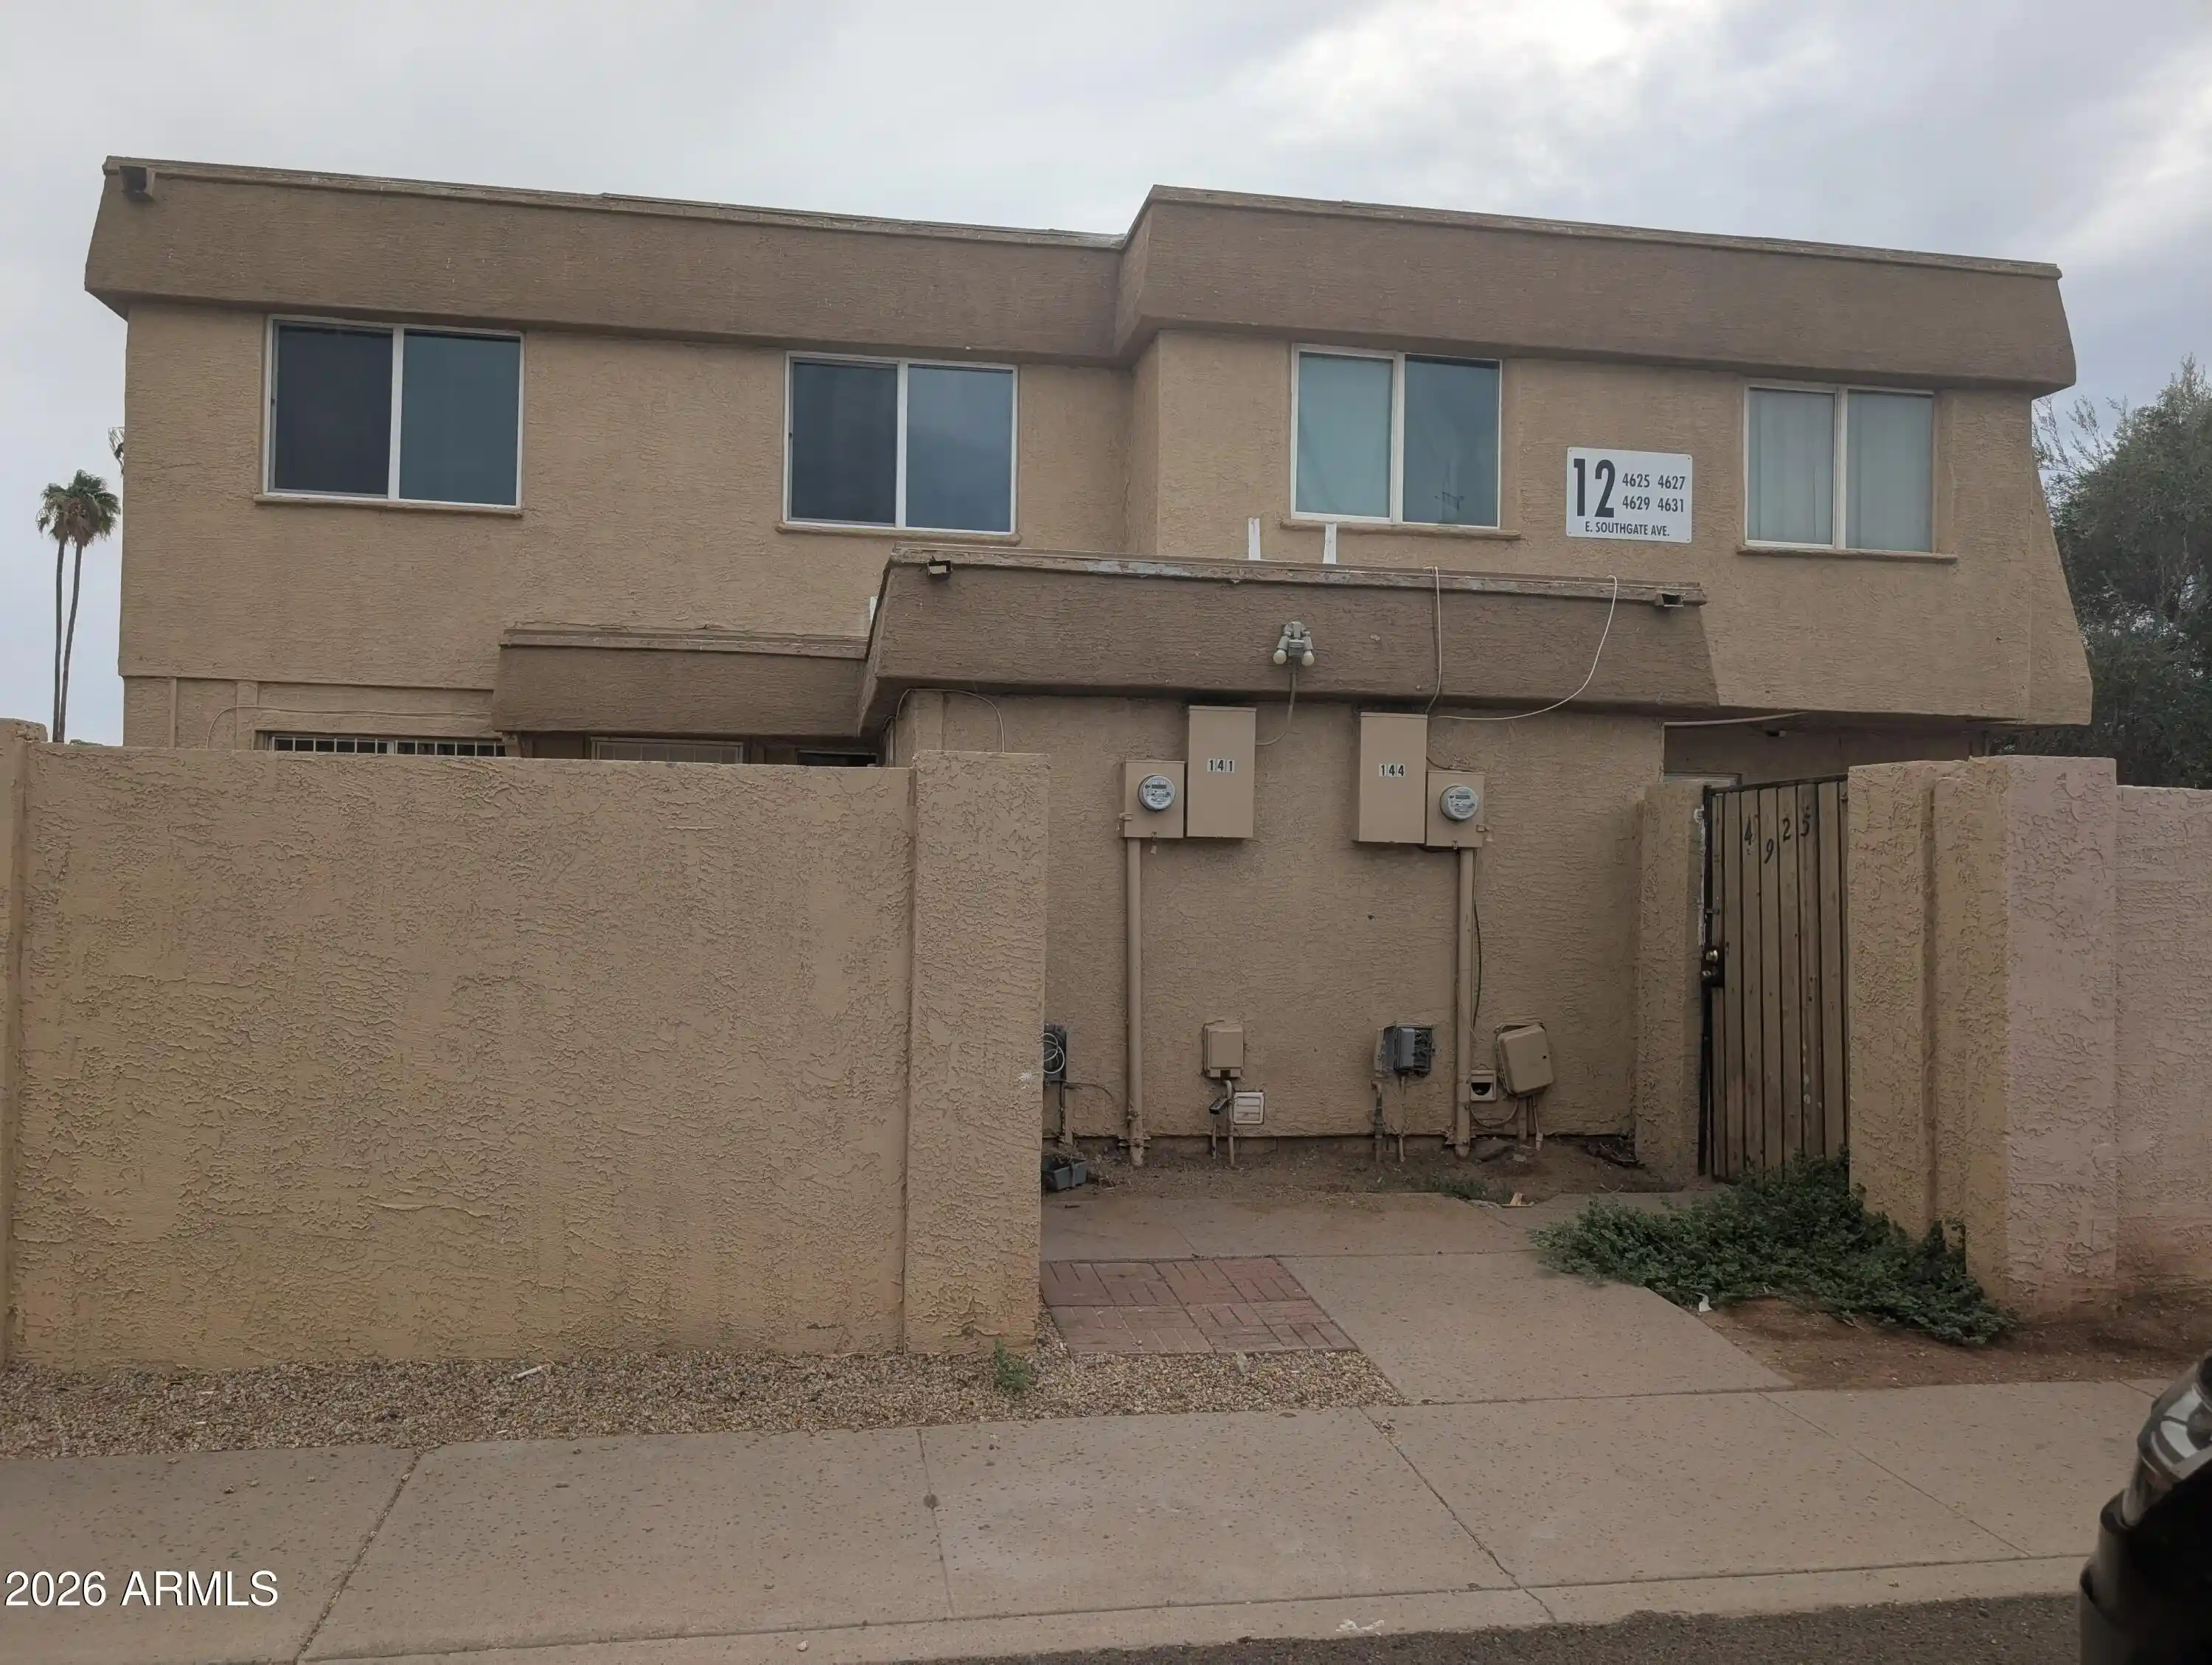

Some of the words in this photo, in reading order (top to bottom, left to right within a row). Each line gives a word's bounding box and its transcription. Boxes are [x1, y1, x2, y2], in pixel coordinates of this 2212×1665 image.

[1573, 458, 1615, 518] 12
[1622, 473, 1650, 488] 4625
[1658, 475, 1686, 490] 4627
[1622, 496, 1650, 510] 4629
[1658, 498, 1684, 512] 4631
[1585, 521, 1593, 533] E.
[1596, 521, 1648, 535] SOUTHGATE
[1651, 525, 1670, 537] AVE.
[1208, 759, 1233, 772] 141
[1380, 764, 1404, 776] 144
